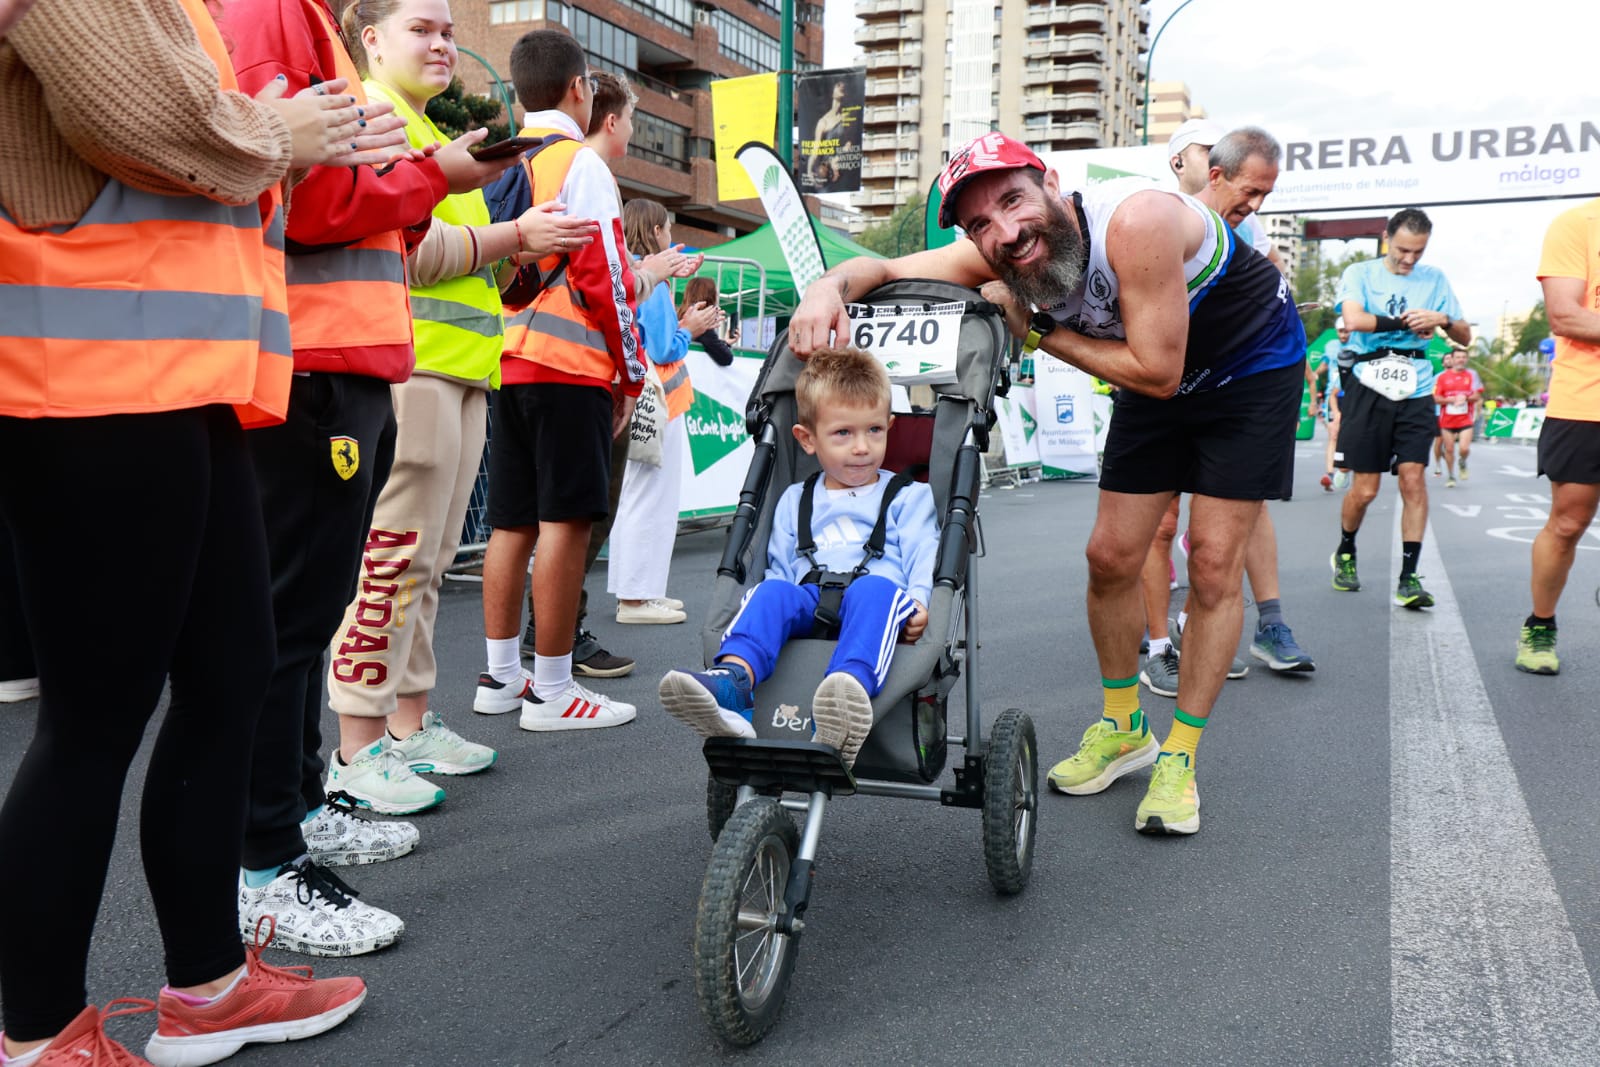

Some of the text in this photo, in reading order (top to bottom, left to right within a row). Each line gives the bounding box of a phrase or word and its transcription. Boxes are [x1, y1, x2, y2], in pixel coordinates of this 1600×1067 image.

[1356, 178, 1371, 190] de
[1499, 163, 1581, 186] málaga
[854, 318, 940, 350] 6740
[1375, 367, 1409, 382] 1848
[332, 527, 418, 686] ADIDAS
